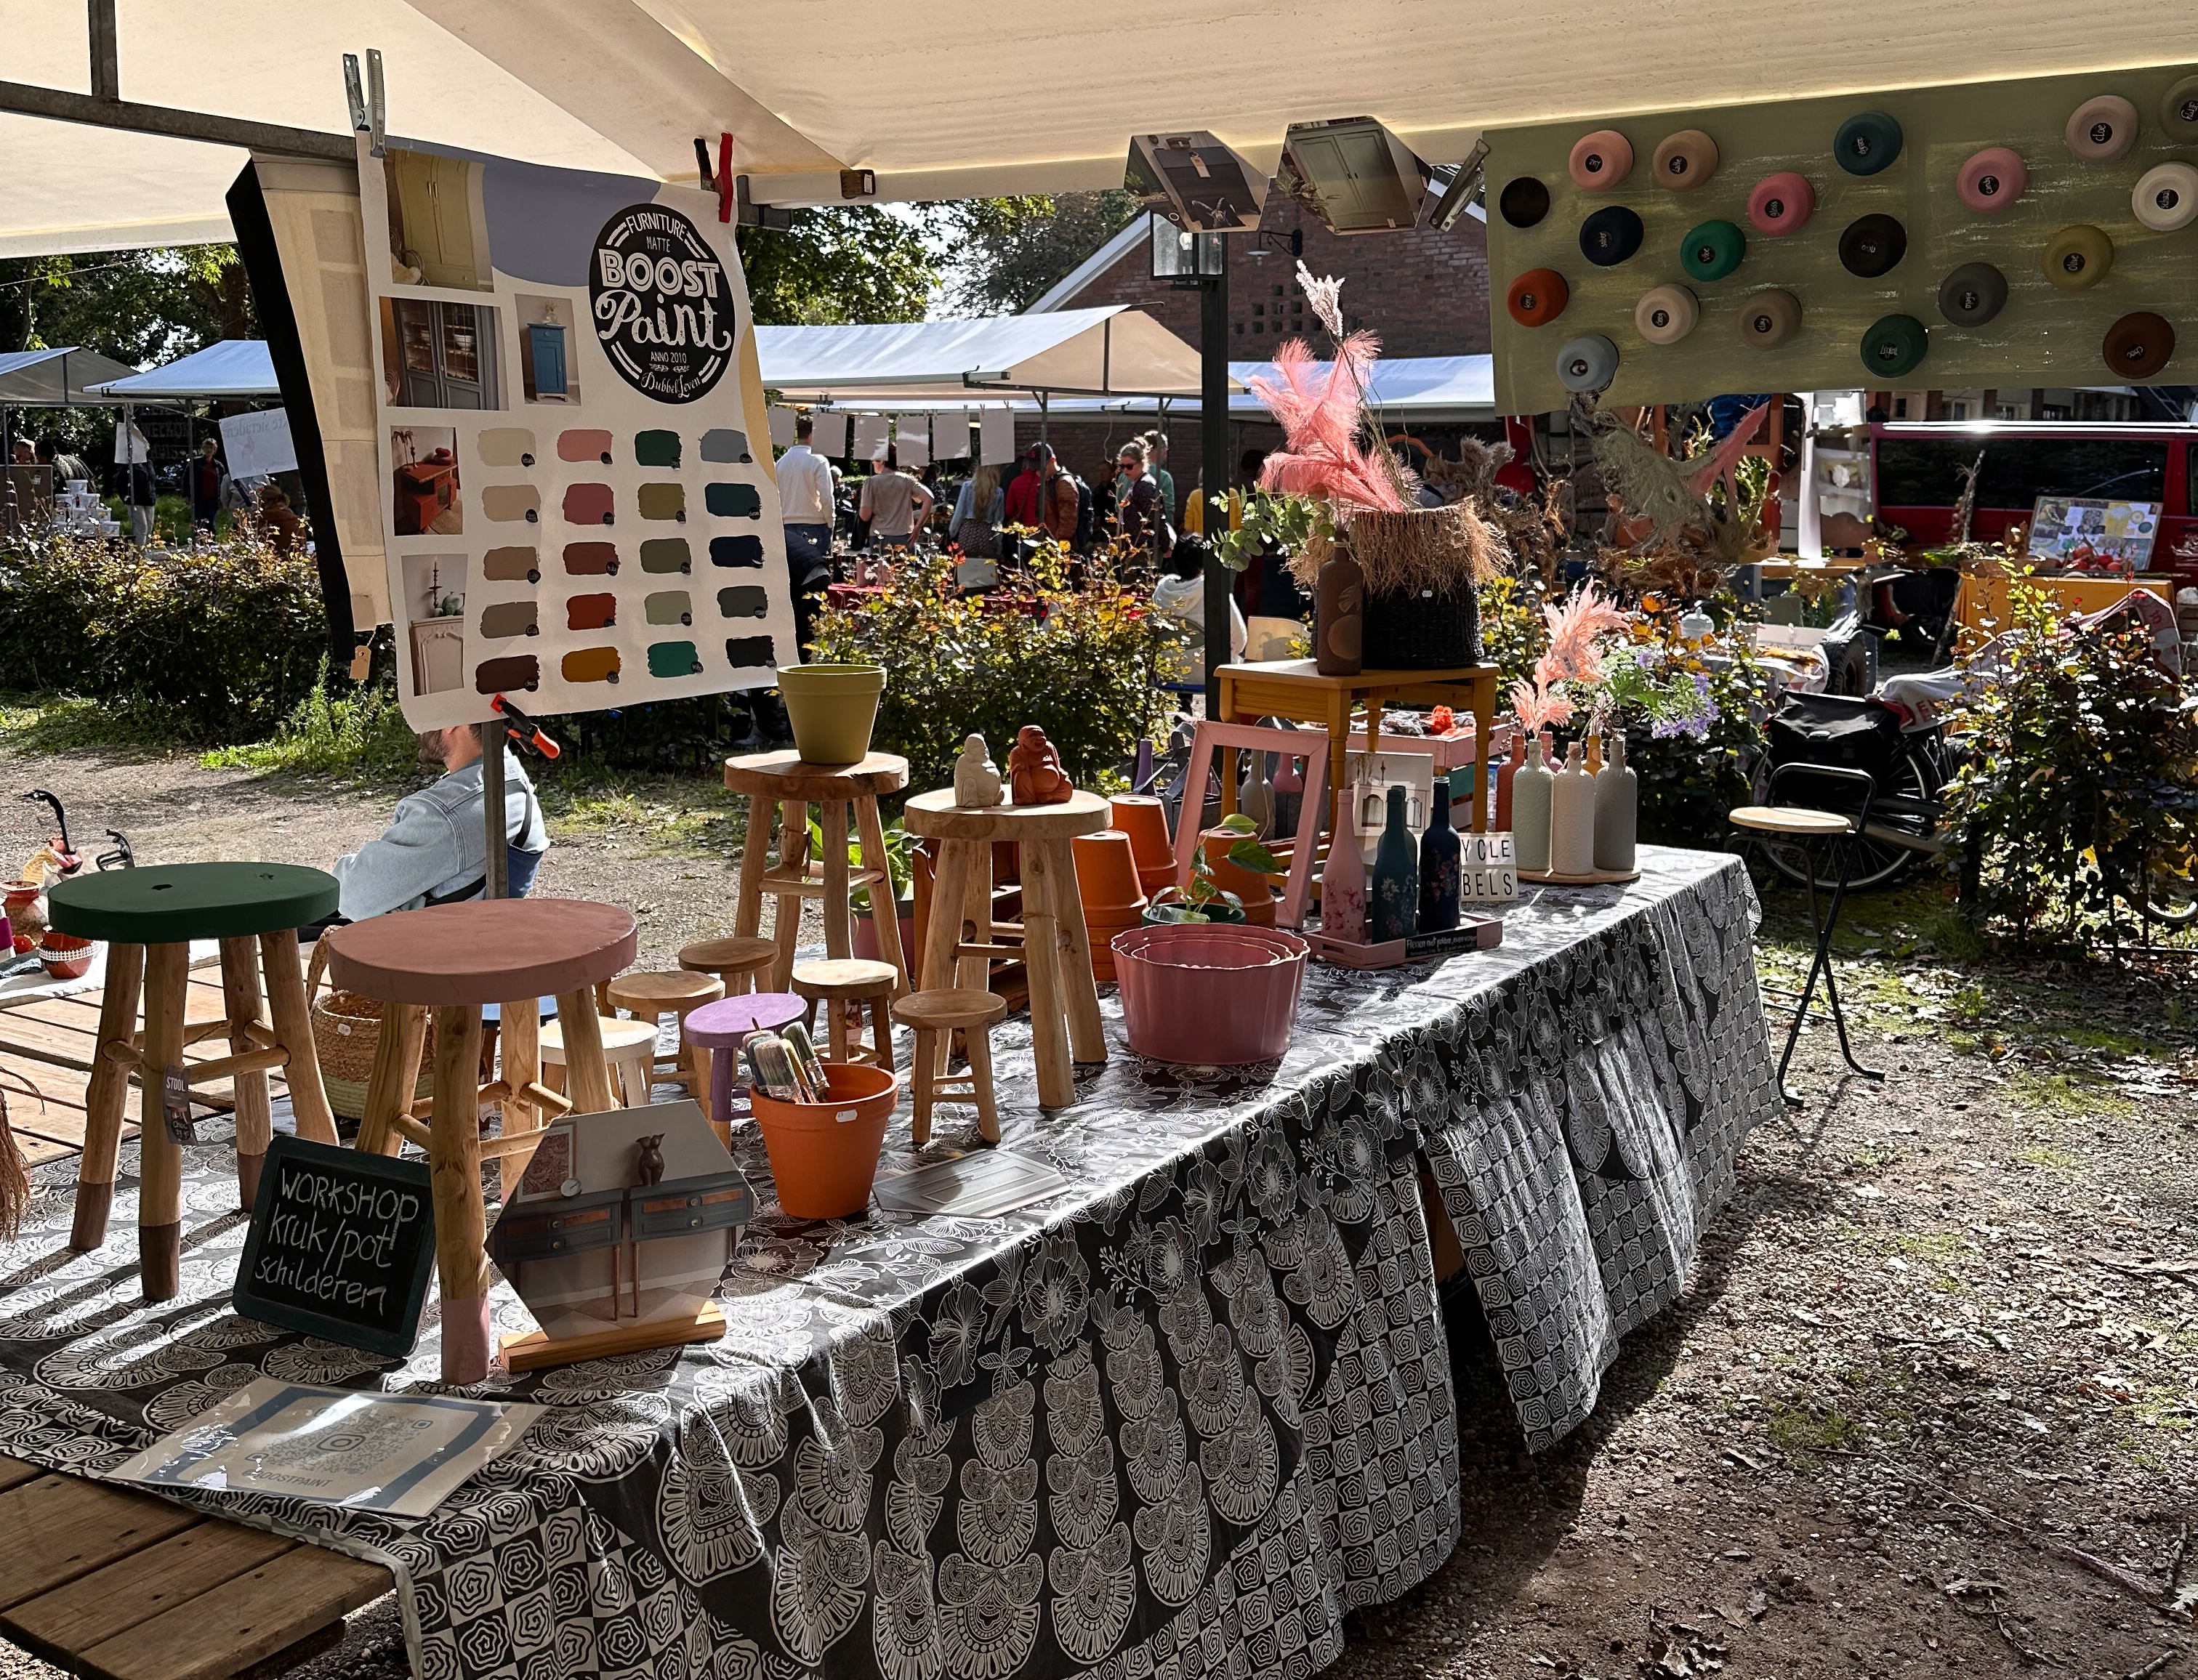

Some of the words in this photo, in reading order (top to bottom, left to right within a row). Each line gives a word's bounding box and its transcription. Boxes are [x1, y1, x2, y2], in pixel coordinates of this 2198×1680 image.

[626, 212, 686, 241] FURNITURE
[646, 236, 671, 253] MATTE
[598, 249, 719, 298] BOOST
[595, 290, 732, 351] Paint
[651, 351, 669, 362] ANNO
[670, 352, 687, 363] 2010
[166, 1076, 186, 1092] STOOL
[254, 1255, 387, 1316] schilderen
